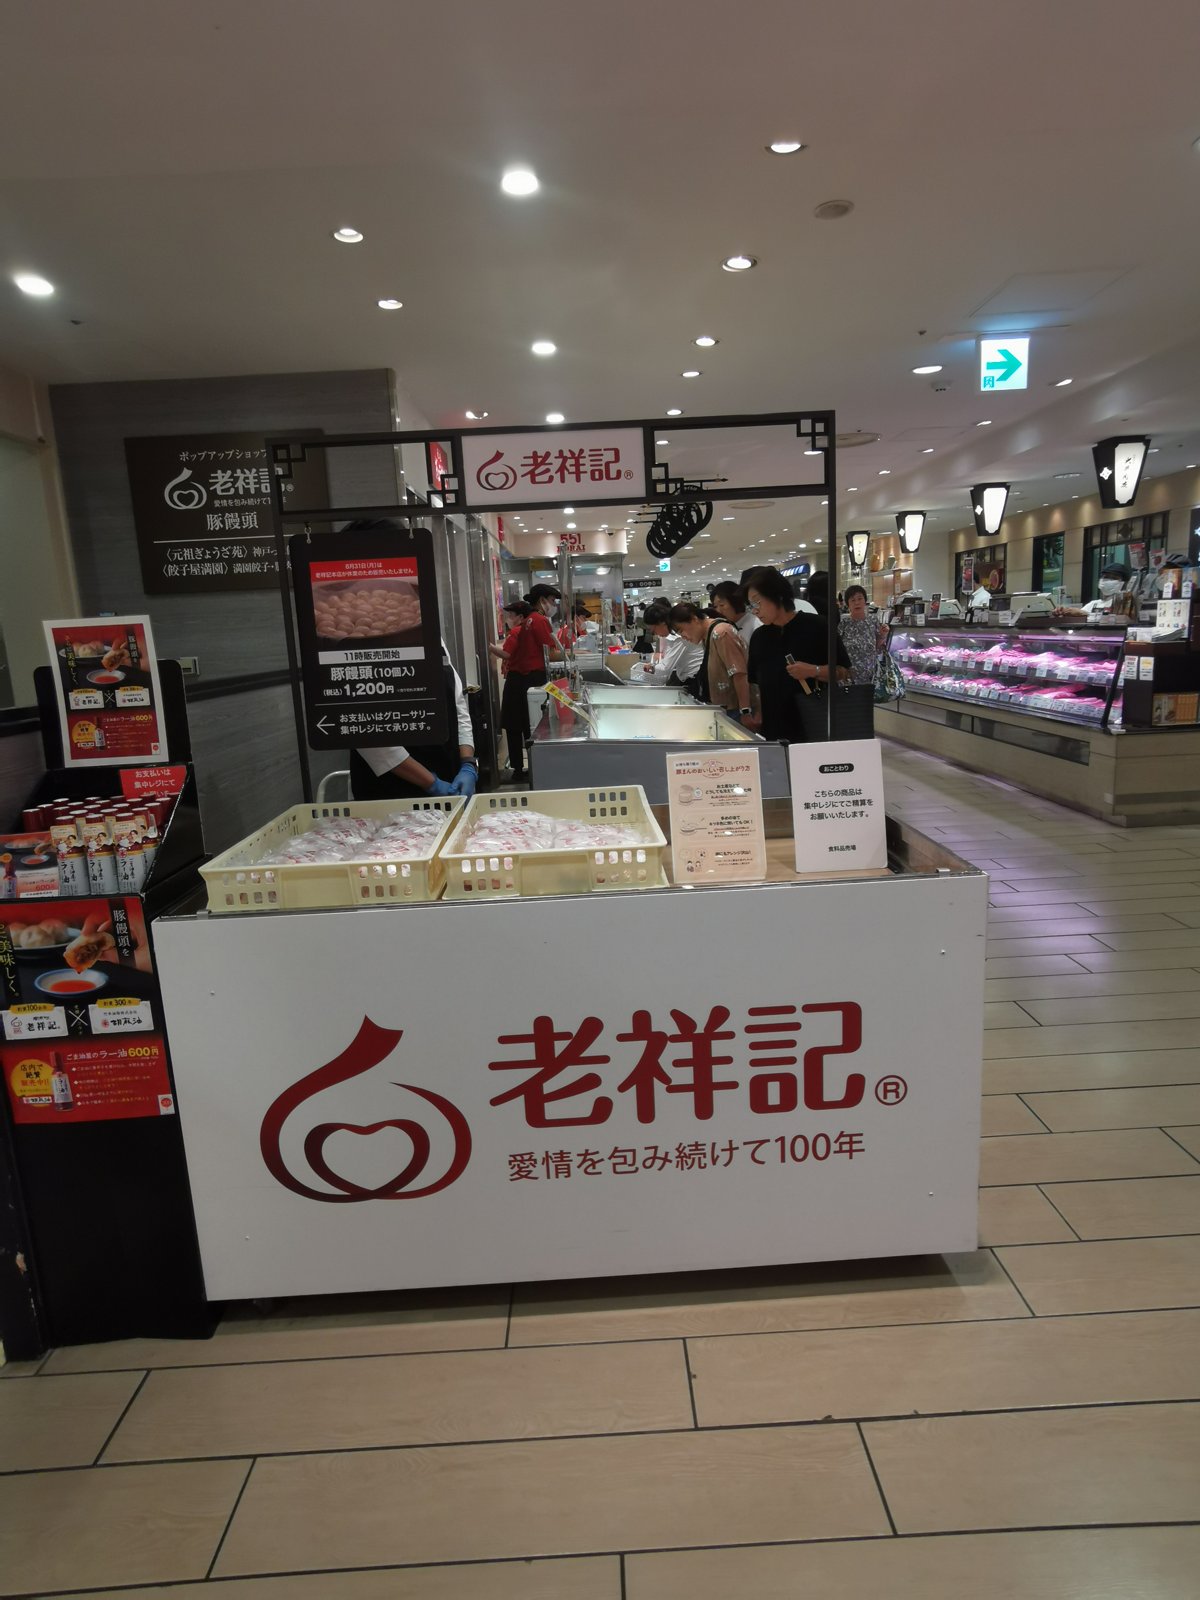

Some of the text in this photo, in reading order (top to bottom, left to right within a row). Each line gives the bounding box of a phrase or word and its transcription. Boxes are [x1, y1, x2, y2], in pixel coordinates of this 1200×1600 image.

[520, 446, 622, 485] 老祥記
[206, 511, 259, 531] 豚饅頭
[559, 533, 581, 545] 551
[344, 649, 401, 661] 11時販売開始
[330, 665, 415, 681] 豚饅頭(10個入)
[339, 709, 436, 723] お支払いはグローサリー
[340, 721, 431, 735] 集中レジにて承ります。
[135, 768, 171, 778] お支払いは
[134, 779, 175, 789] 集中レジにて
[814, 788, 863, 798] こちらの商品は
[803, 798, 874, 810] 集中レジにてご精算を
[809, 810, 869, 821] お願いいたします。
[112, 909, 131, 957] 豚饅頭を
[486, 1000, 866, 1129] 老祥記
[507, 1130, 866, 1183] 愛情を包み続けて100年
